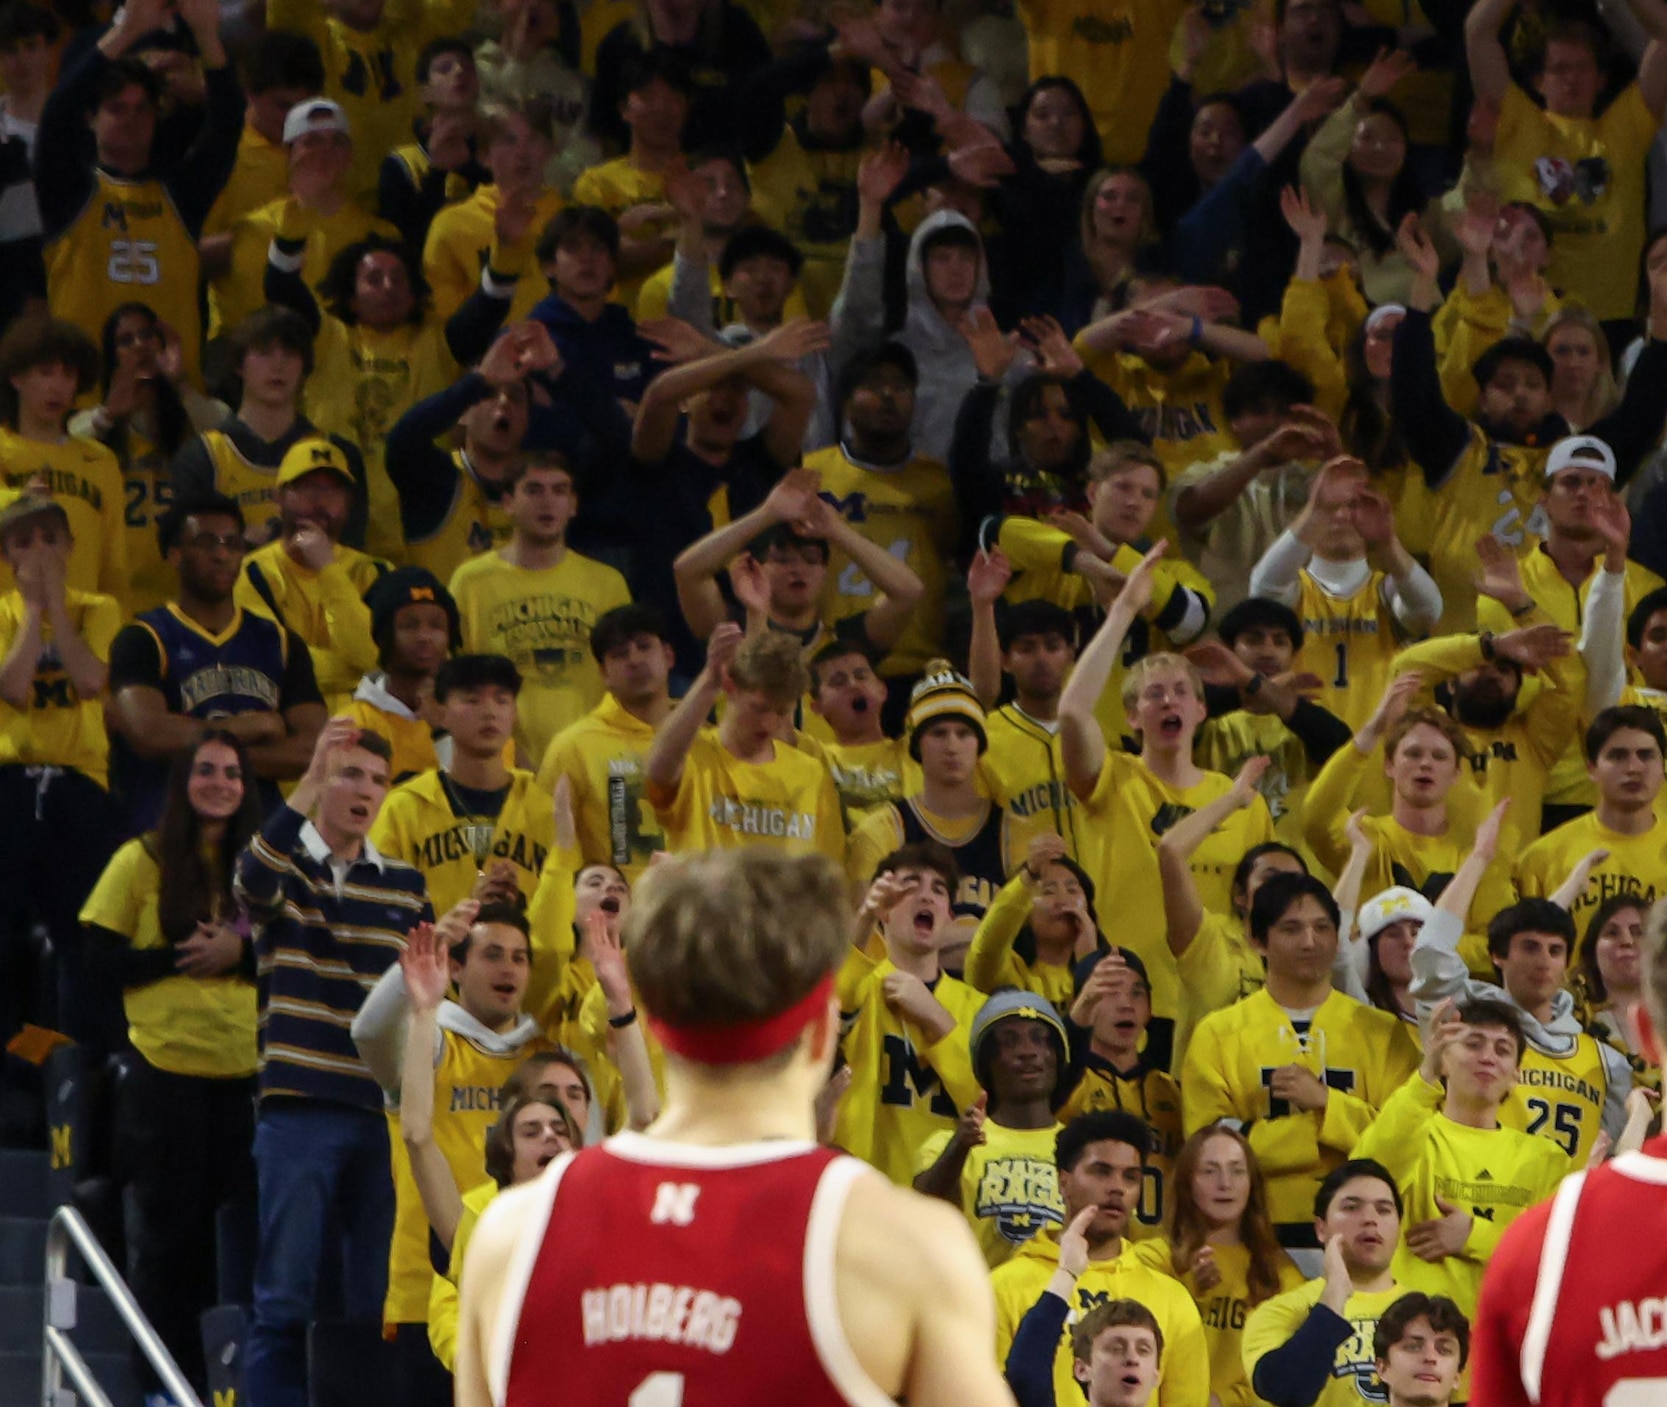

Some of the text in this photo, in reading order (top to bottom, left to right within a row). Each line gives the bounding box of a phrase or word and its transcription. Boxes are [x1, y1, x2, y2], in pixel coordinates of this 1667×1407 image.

[110, 241, 159, 285] 25
[1331, 643, 1348, 688] 1
[1567, 873, 1652, 916] ICHIGA
[881, 1032, 958, 1118] M
[1519, 1068, 1601, 1108] ICHIGAN
[449, 1084, 503, 1113] MICH
[1525, 1098, 1582, 1160] 25
[985, 1158, 1060, 1183] MAIZ
[650, 1182, 701, 1227] N
[582, 1282, 742, 1356] HOIBERG
[1076, 1288, 1108, 1307] M
